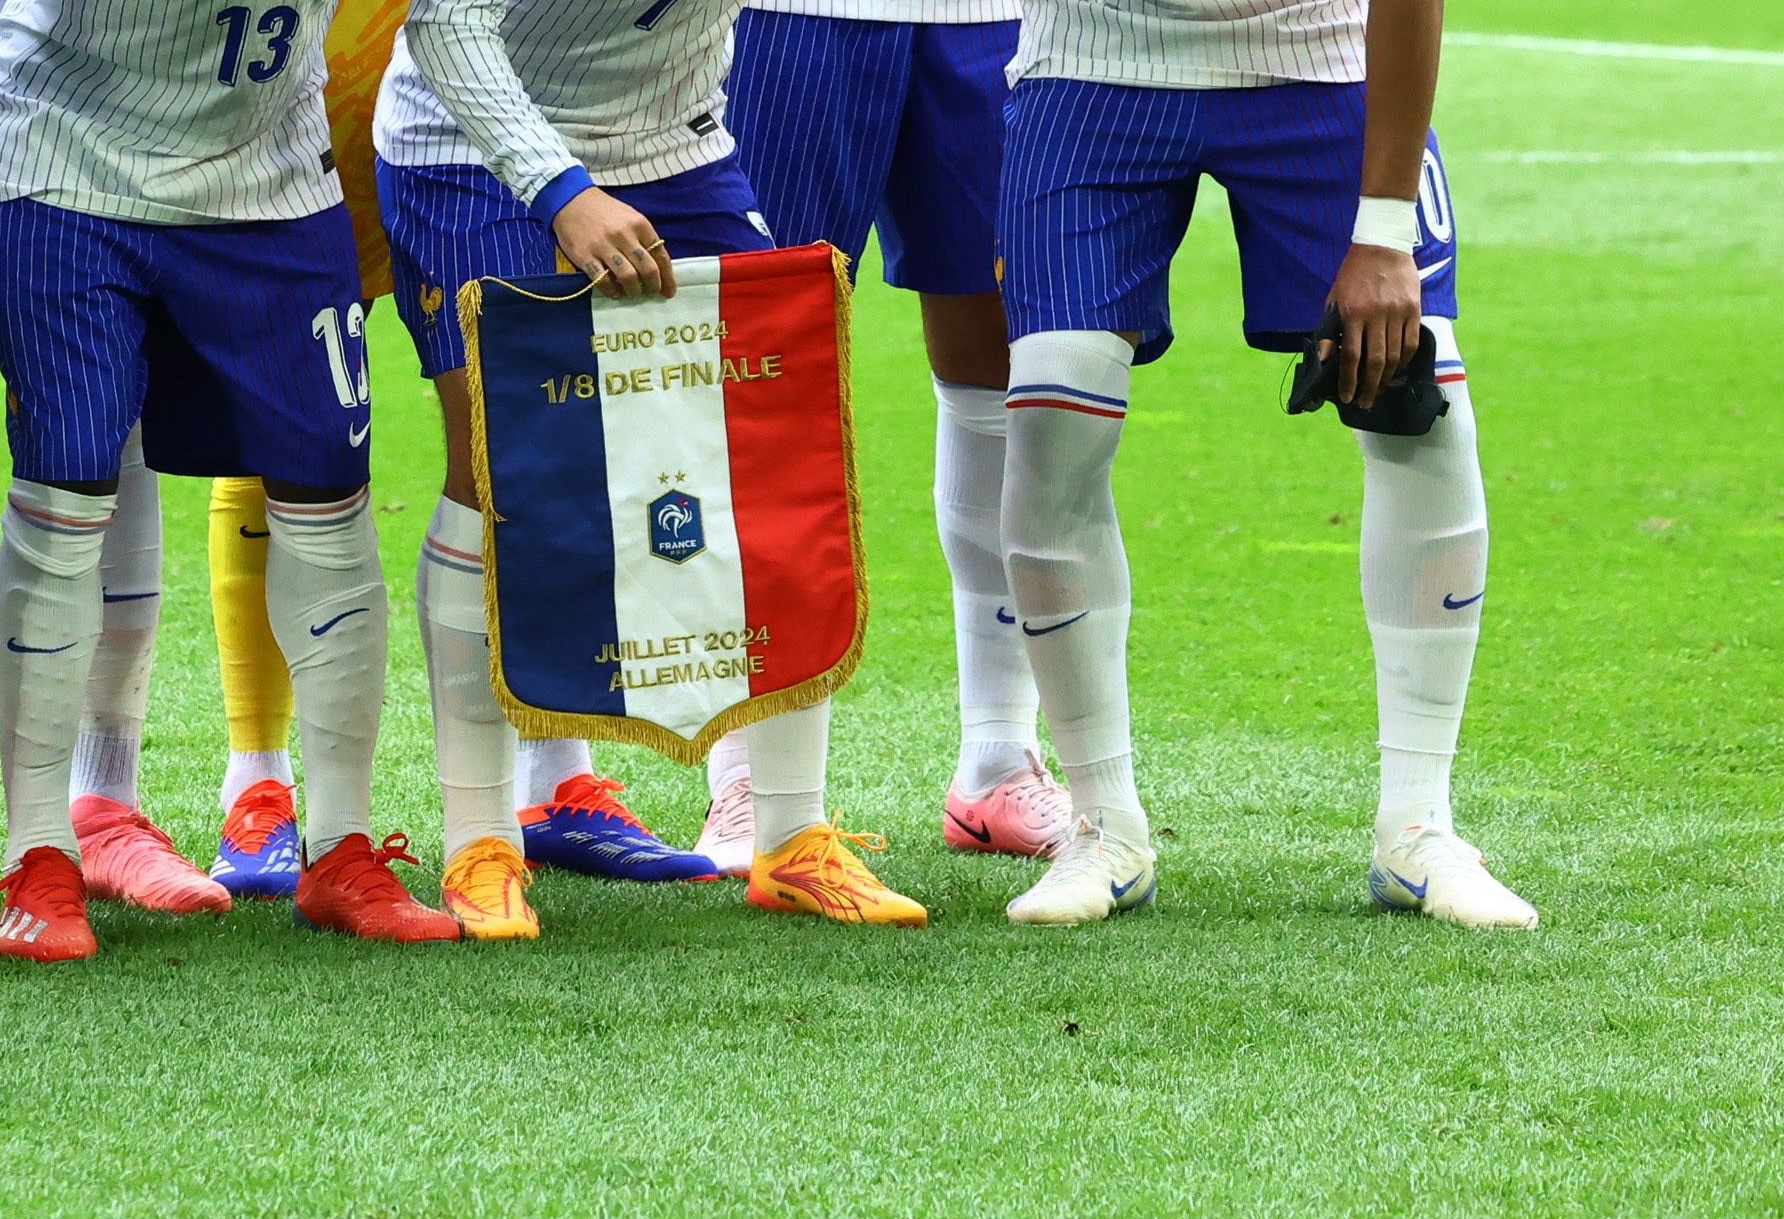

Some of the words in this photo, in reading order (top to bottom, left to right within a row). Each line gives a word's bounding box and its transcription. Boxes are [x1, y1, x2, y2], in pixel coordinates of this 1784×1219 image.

[216, 5, 300, 87] 13
[589, 328, 656, 353] EURO
[664, 320, 729, 345] 2024
[540, 373, 595, 403] 1/8
[605, 367, 654, 396] DE
[661, 355, 783, 390] FINALE
[658, 540, 697, 551] FRANCE
[594, 634, 696, 664] JUILLET
[703, 625, 771, 652] 2024
[609, 655, 765, 692] ALLEMAGNE
